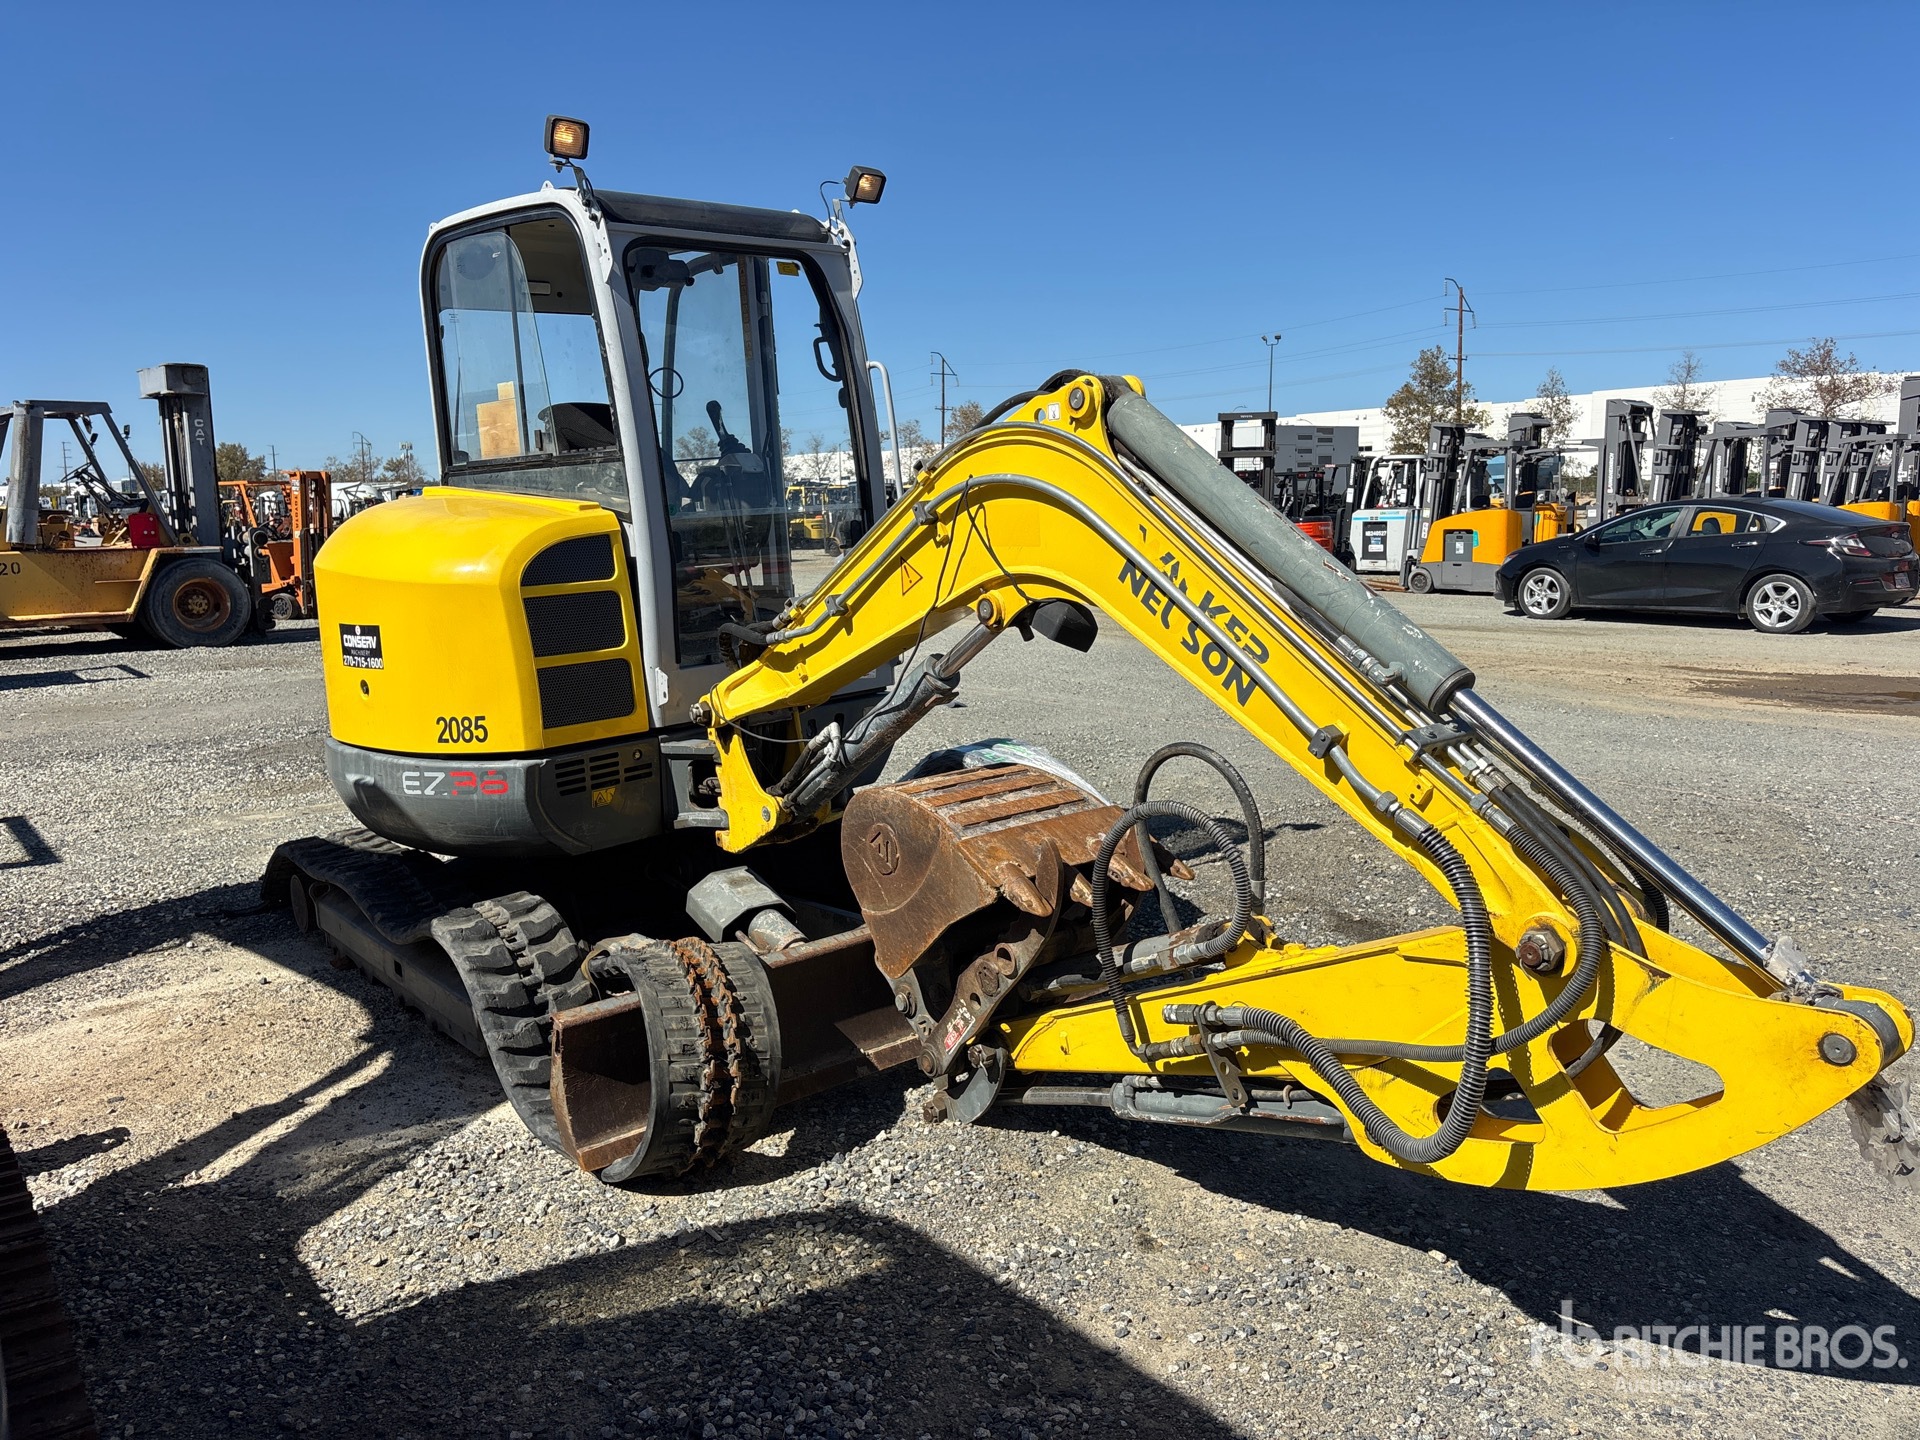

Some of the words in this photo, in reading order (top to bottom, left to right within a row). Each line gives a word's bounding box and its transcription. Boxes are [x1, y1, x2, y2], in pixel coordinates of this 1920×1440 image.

[194, 418, 205, 446] CAT
[343, 634, 377, 649] CONSERV
[343, 655, 383, 669] 270-715-1600
[436, 715, 489, 744] 2085
